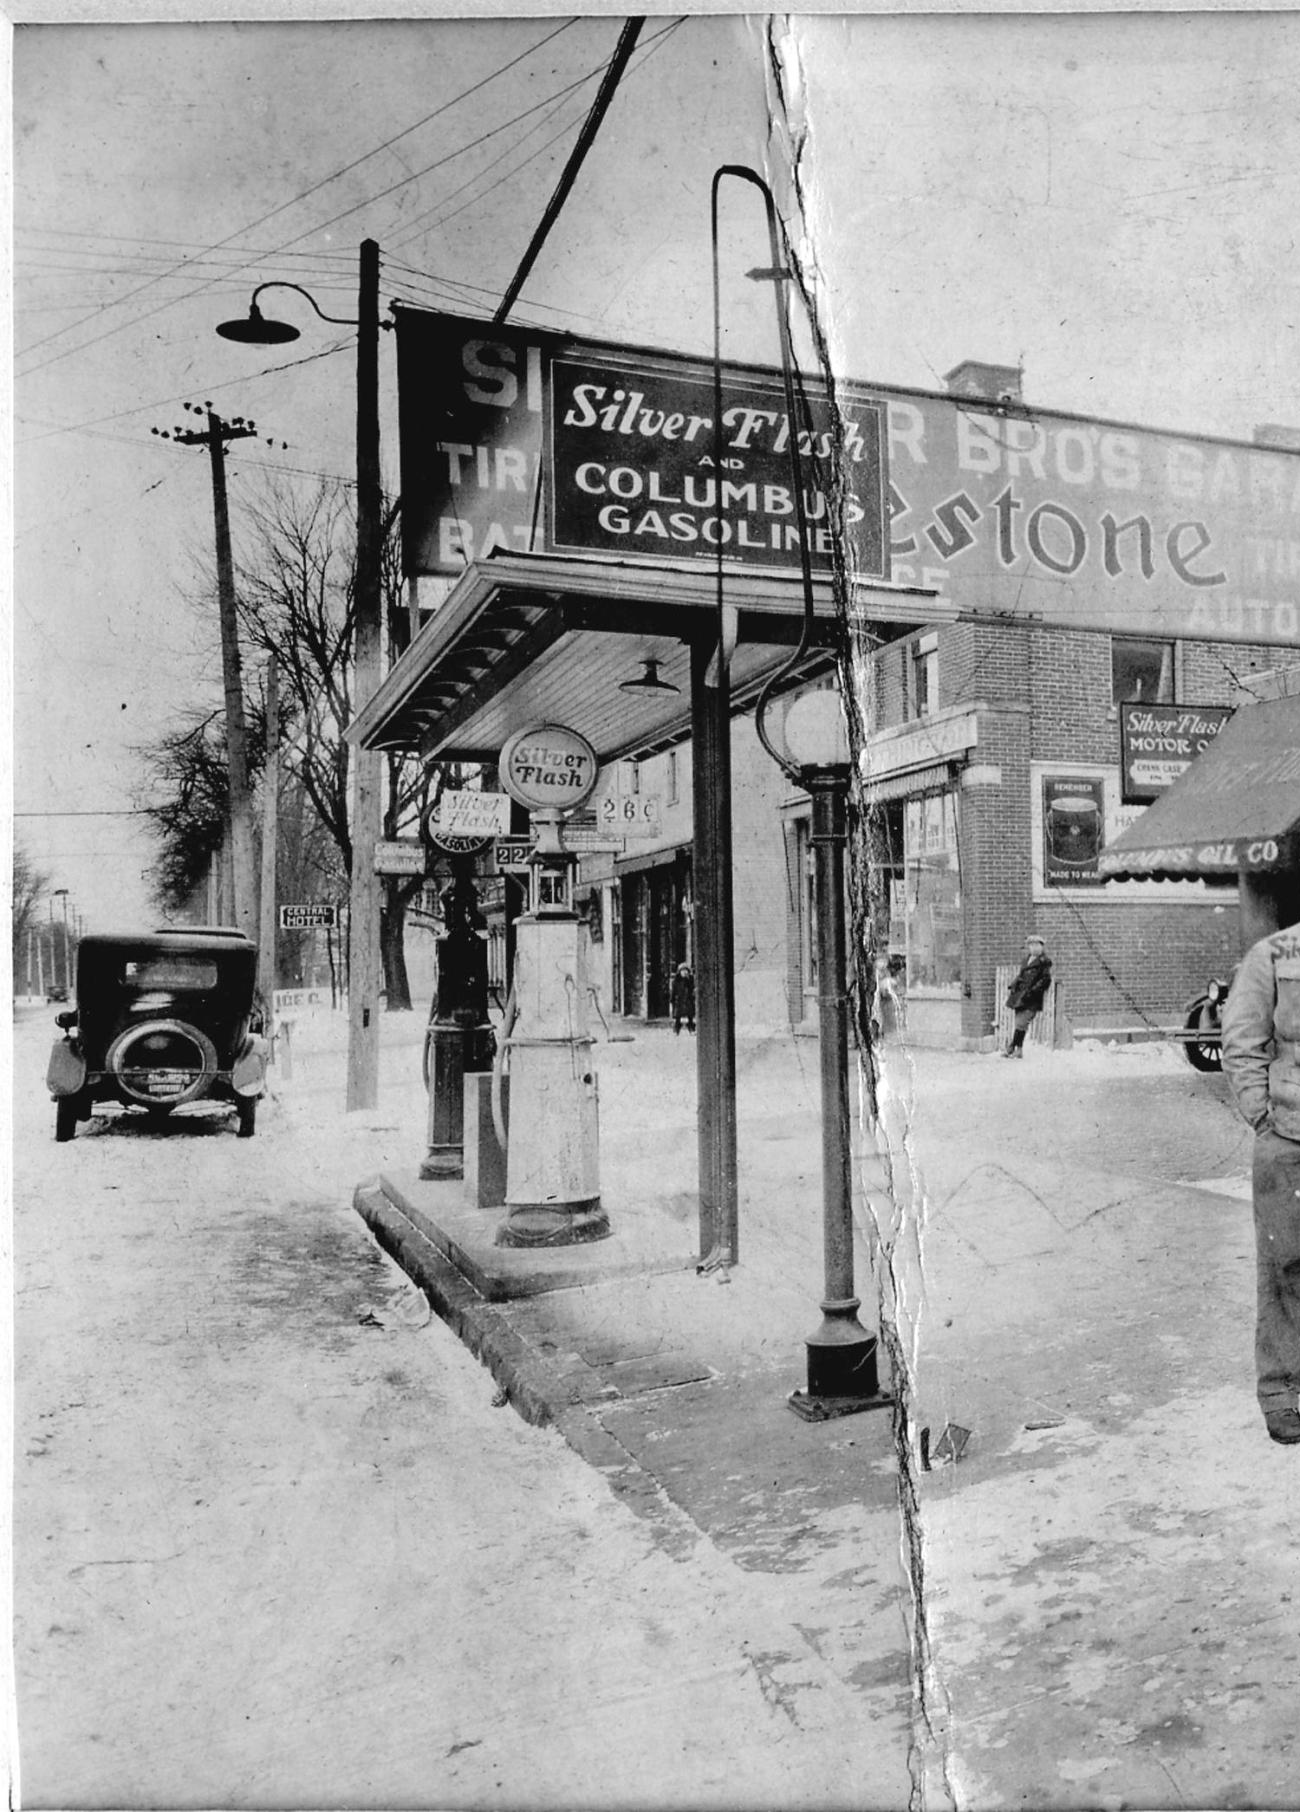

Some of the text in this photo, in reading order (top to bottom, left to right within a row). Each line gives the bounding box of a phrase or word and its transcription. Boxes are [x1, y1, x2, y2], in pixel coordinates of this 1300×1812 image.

[564, 384, 712, 441] Silver
[722, 406, 865, 462] Flash
[436, 441, 541, 491] TIR
[699, 455, 745, 469] AND
[575, 462, 865, 523] COLUMBUS
[598, 505, 836, 553] GASOLINE
[1189, 598, 1298, 636] AUTO
[1127, 711, 1177, 734] Silver
[1130, 737, 1192, 754] MOTOR
[515, 747, 587, 768] Silver
[515, 765, 583, 787] Flash
[449, 811, 499, 828] Flash
[287, 906, 330, 916] CENTRAL
[287, 916, 330, 926] HOTEL
